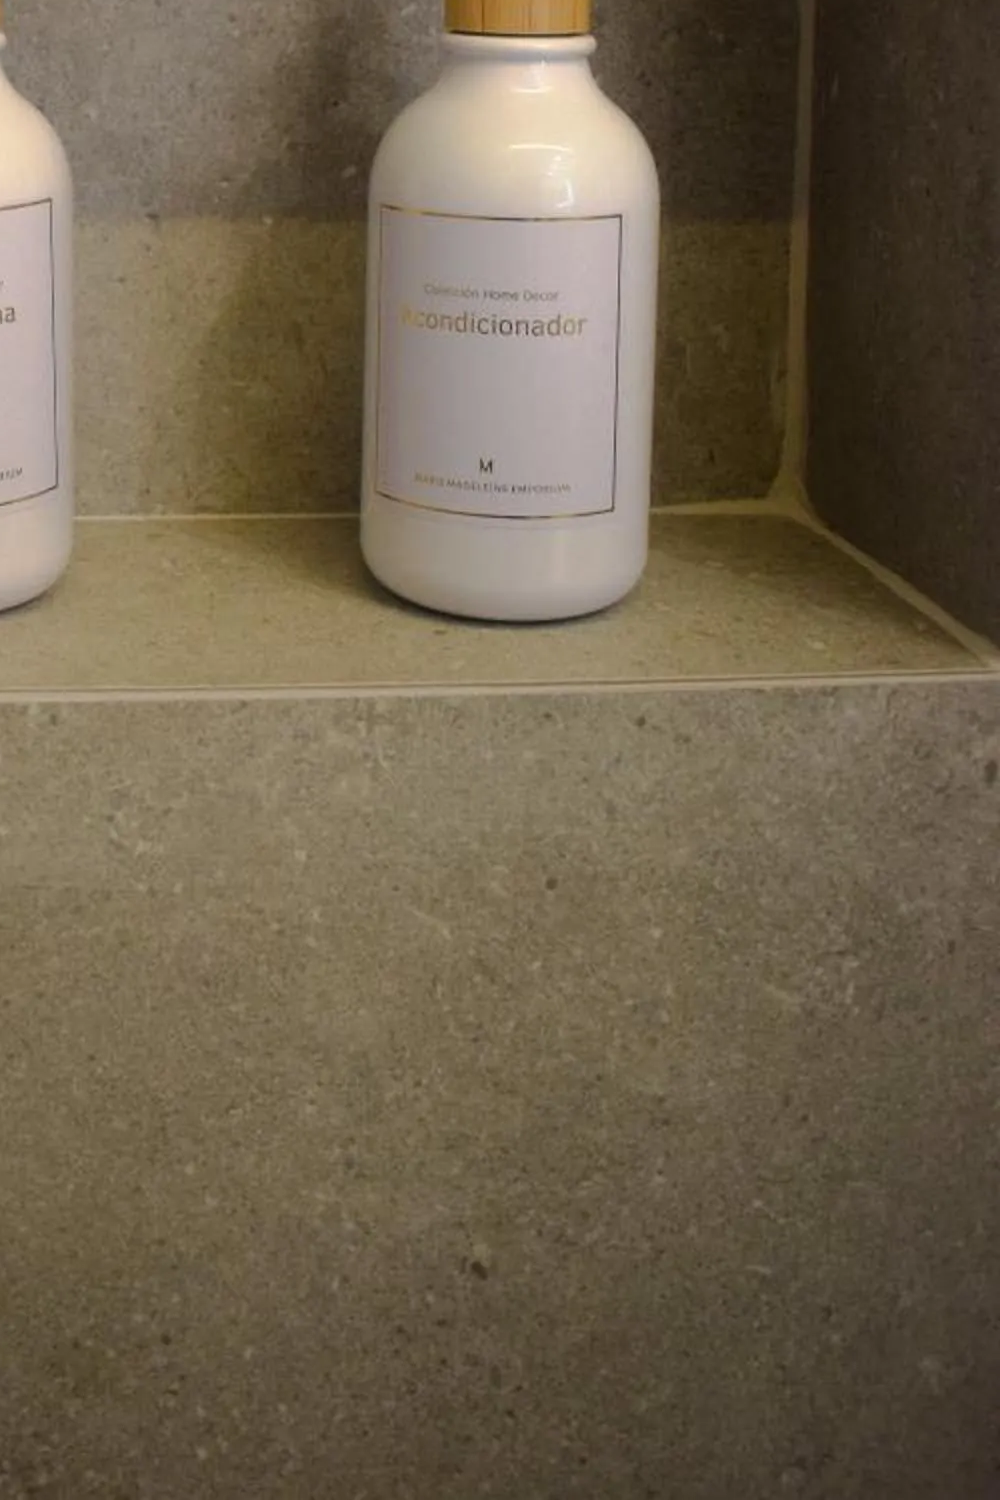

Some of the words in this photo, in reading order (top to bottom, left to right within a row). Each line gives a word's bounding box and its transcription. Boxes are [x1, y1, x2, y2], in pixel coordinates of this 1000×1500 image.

[483, 289, 519, 301] Home
[523, 289, 559, 301] Decor
[479, 458, 493, 474] M
